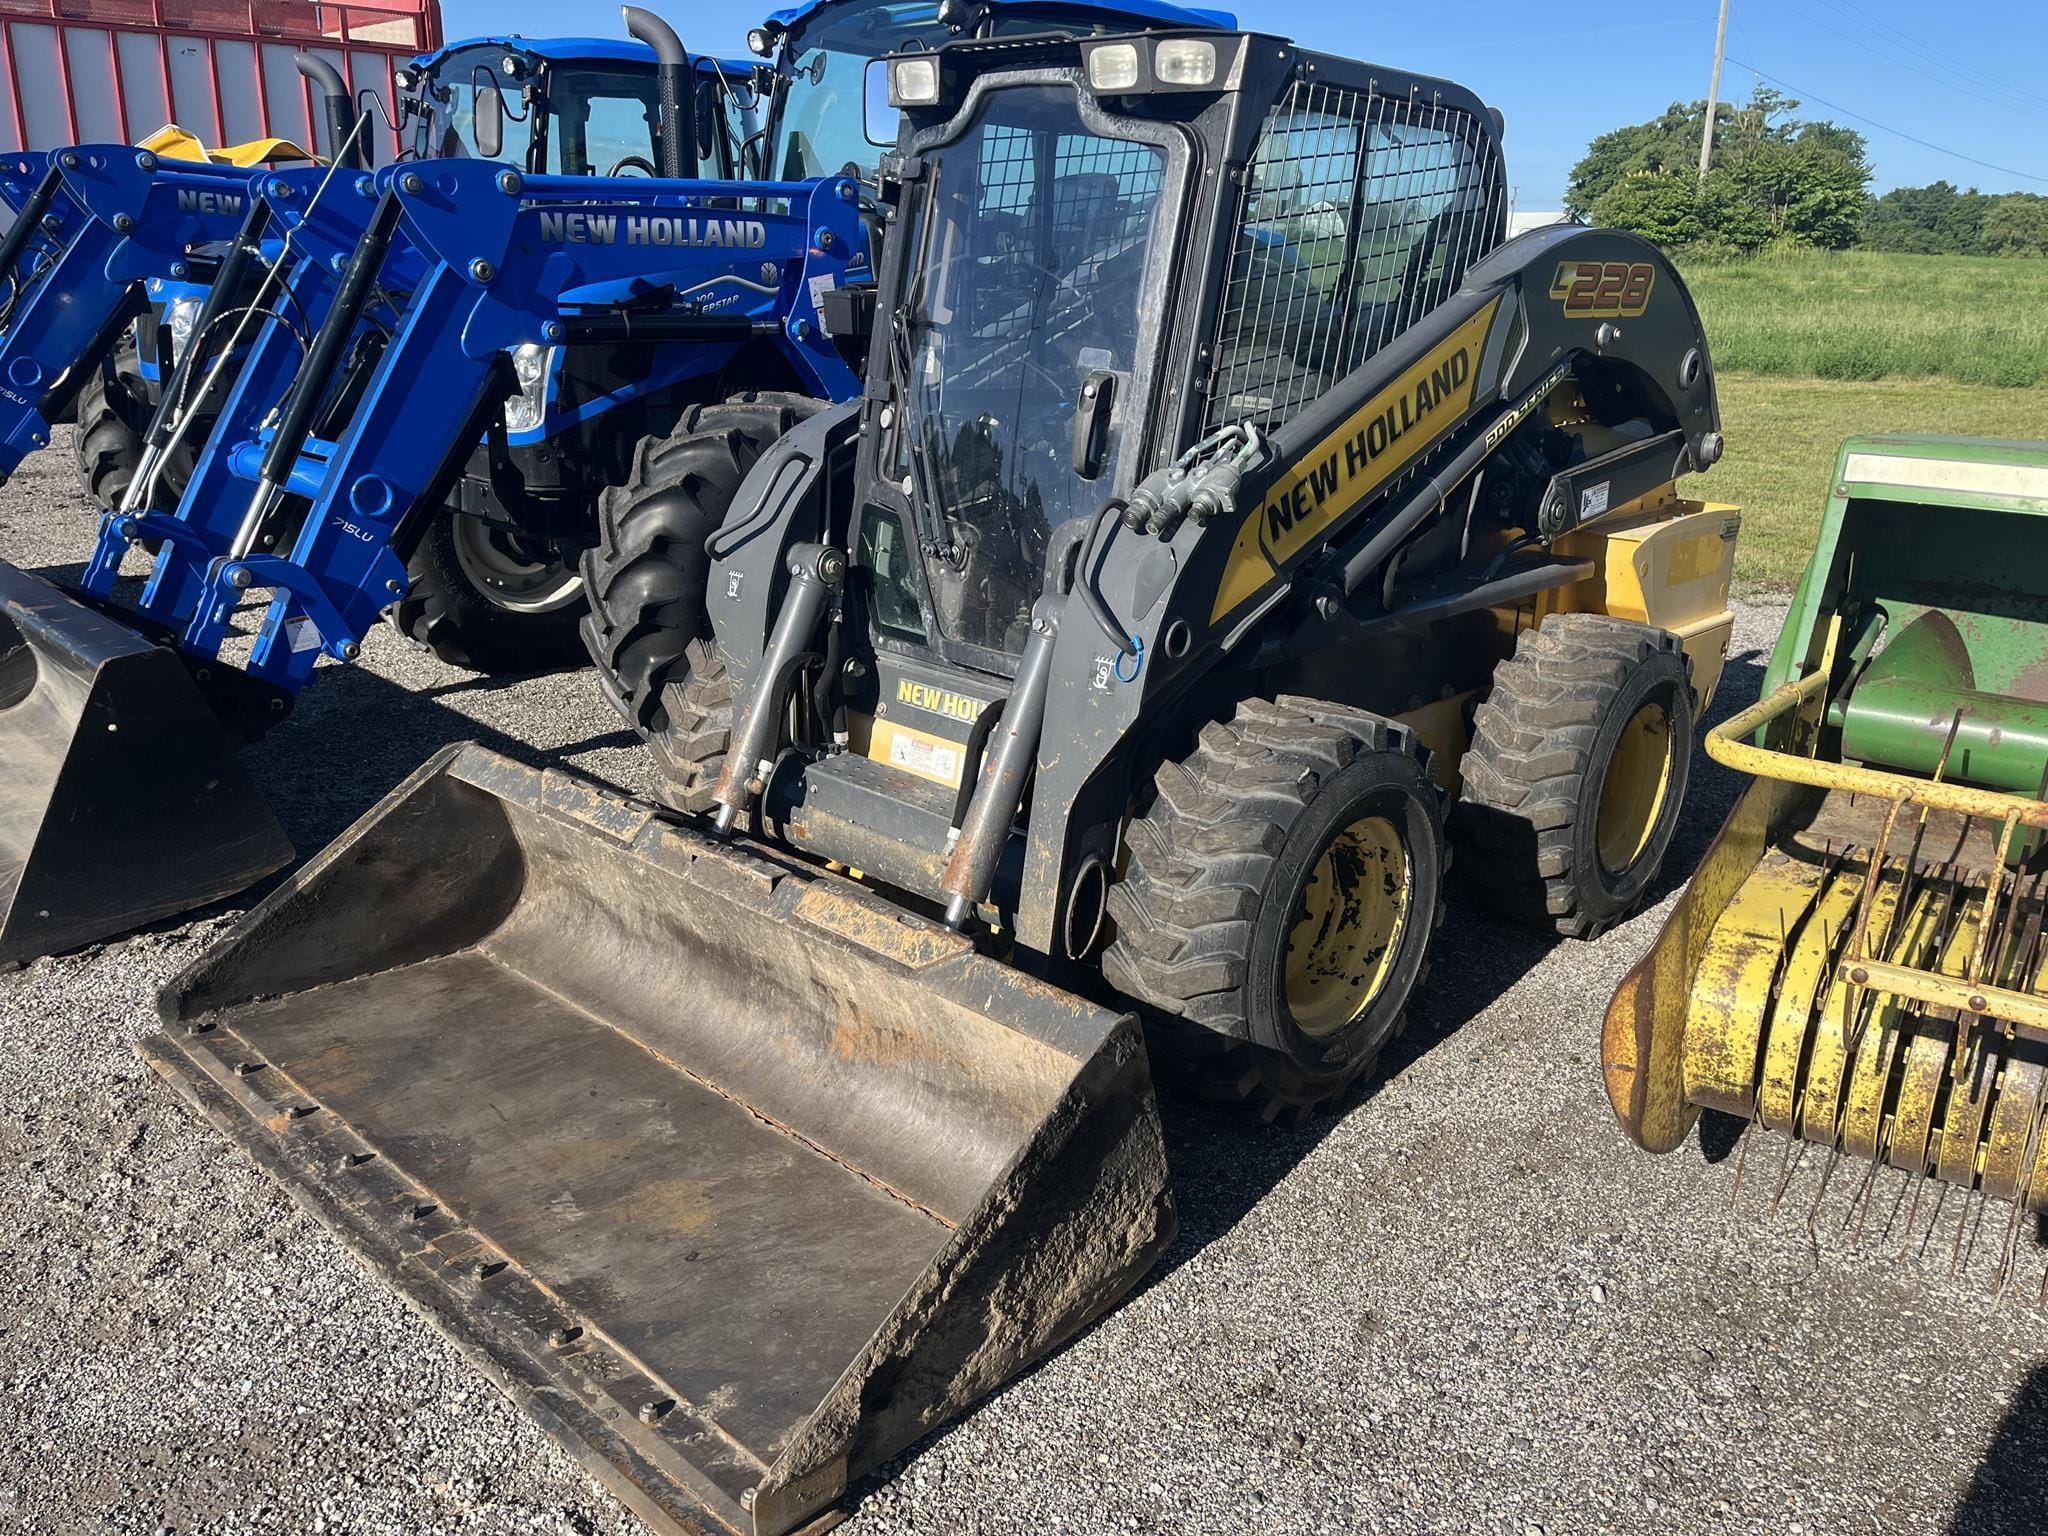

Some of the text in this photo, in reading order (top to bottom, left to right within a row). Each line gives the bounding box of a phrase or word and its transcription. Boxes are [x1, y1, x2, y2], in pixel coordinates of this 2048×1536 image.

[177, 189, 241, 217] NEW
[539, 211, 766, 248] NEW HOLLAND
[702, 294, 740, 314] ERSTAR
[1550, 261, 1655, 318] L228
[1266, 346, 1470, 544] NEW HOLLAND
[1485, 412, 1516, 450] 200
[332, 516, 374, 542] 715LU
[898, 680, 988, 721] NEW HOL
